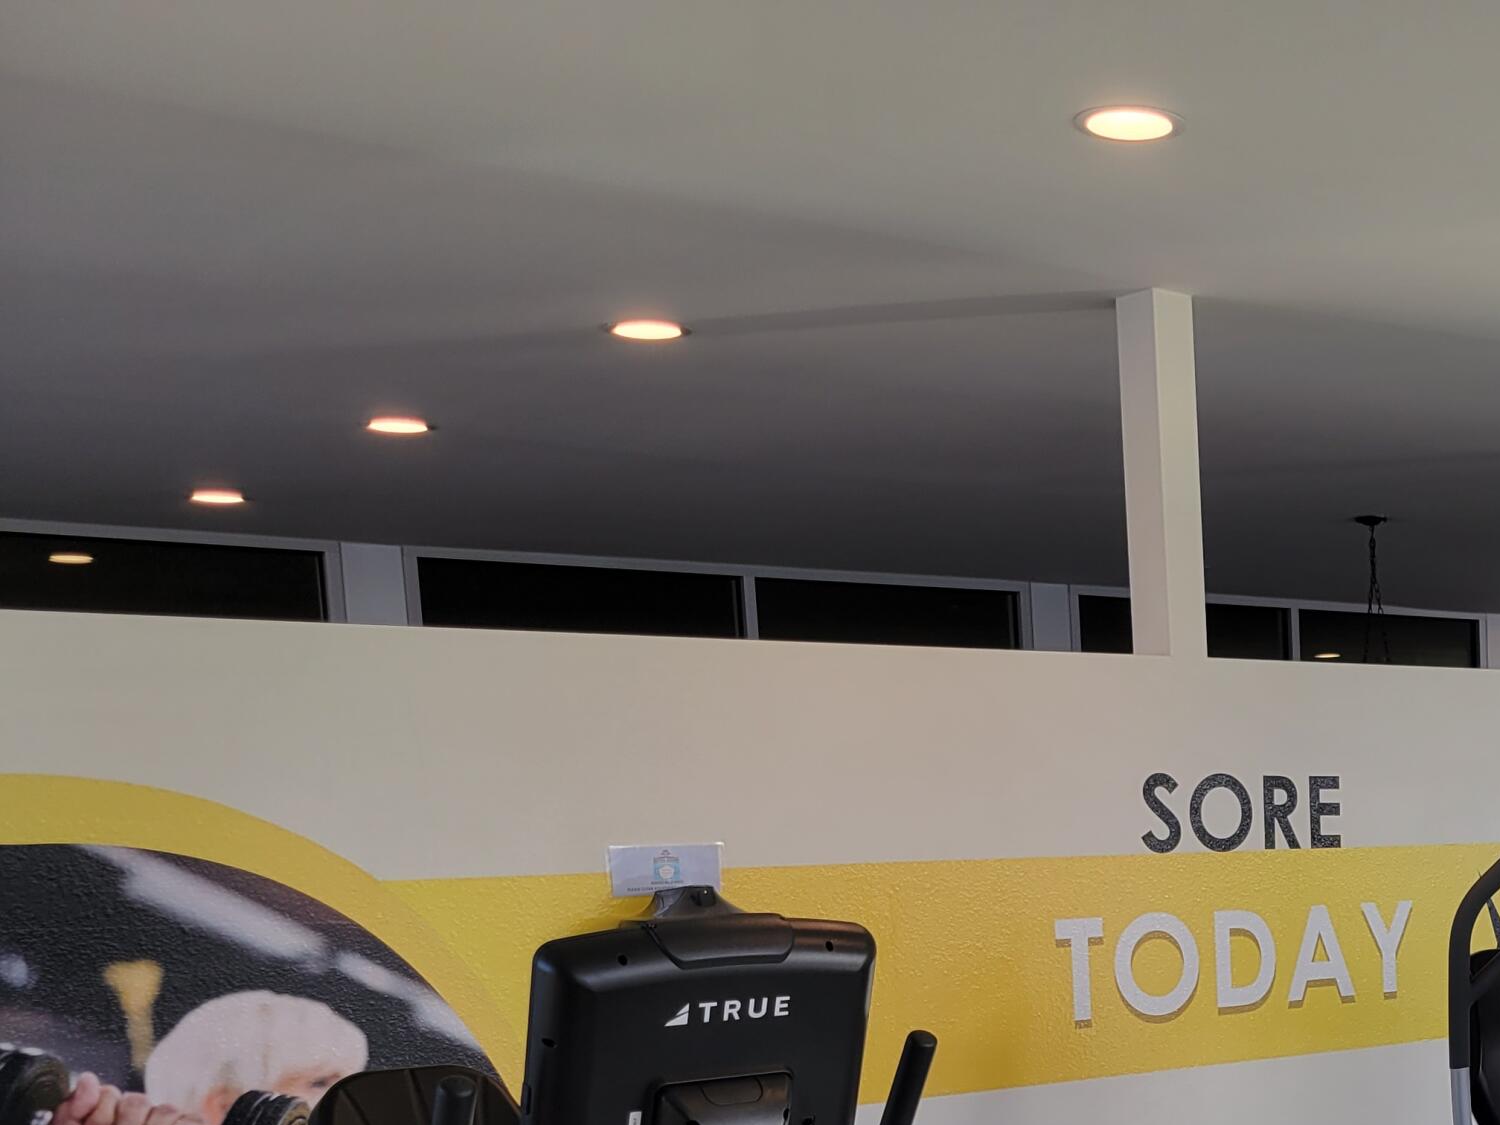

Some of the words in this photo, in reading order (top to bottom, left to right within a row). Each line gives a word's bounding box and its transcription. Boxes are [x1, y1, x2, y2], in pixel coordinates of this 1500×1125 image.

[1141, 772, 1341, 853] SORE
[1055, 900, 1413, 1025] TODAY
[699, 996, 791, 1023] TRUE
